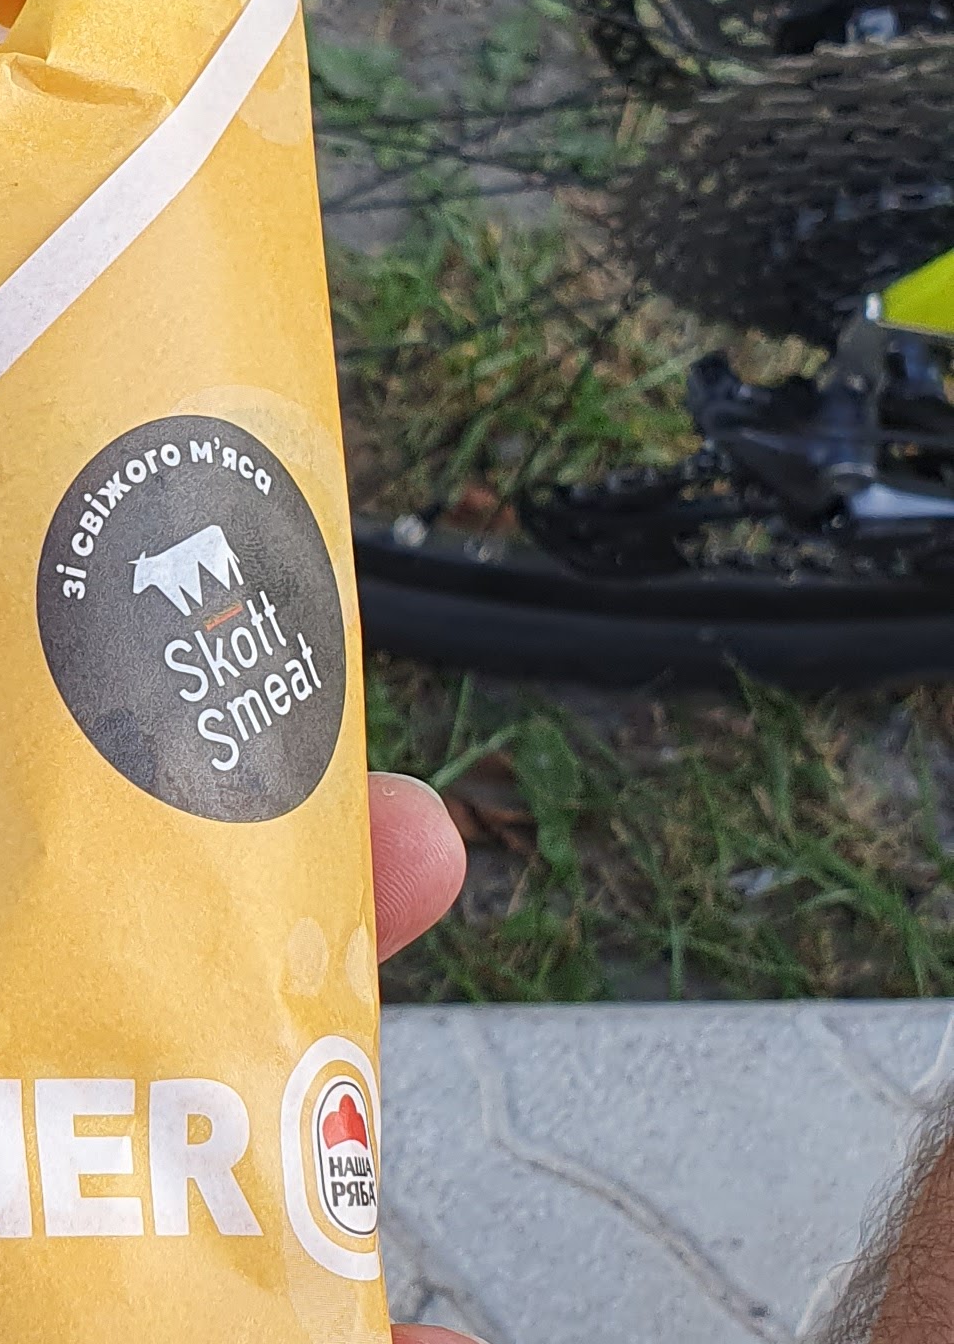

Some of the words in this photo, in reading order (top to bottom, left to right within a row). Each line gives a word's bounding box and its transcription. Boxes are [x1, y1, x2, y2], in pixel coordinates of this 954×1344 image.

[55, 562, 87, 601] зі
[71, 442, 182, 557] свіжого
[189, 435, 274, 496] м'яса
[164, 590, 287, 703] Skott
[196, 632, 322, 772] Smeat
[328, 1156, 373, 1178] НАША
